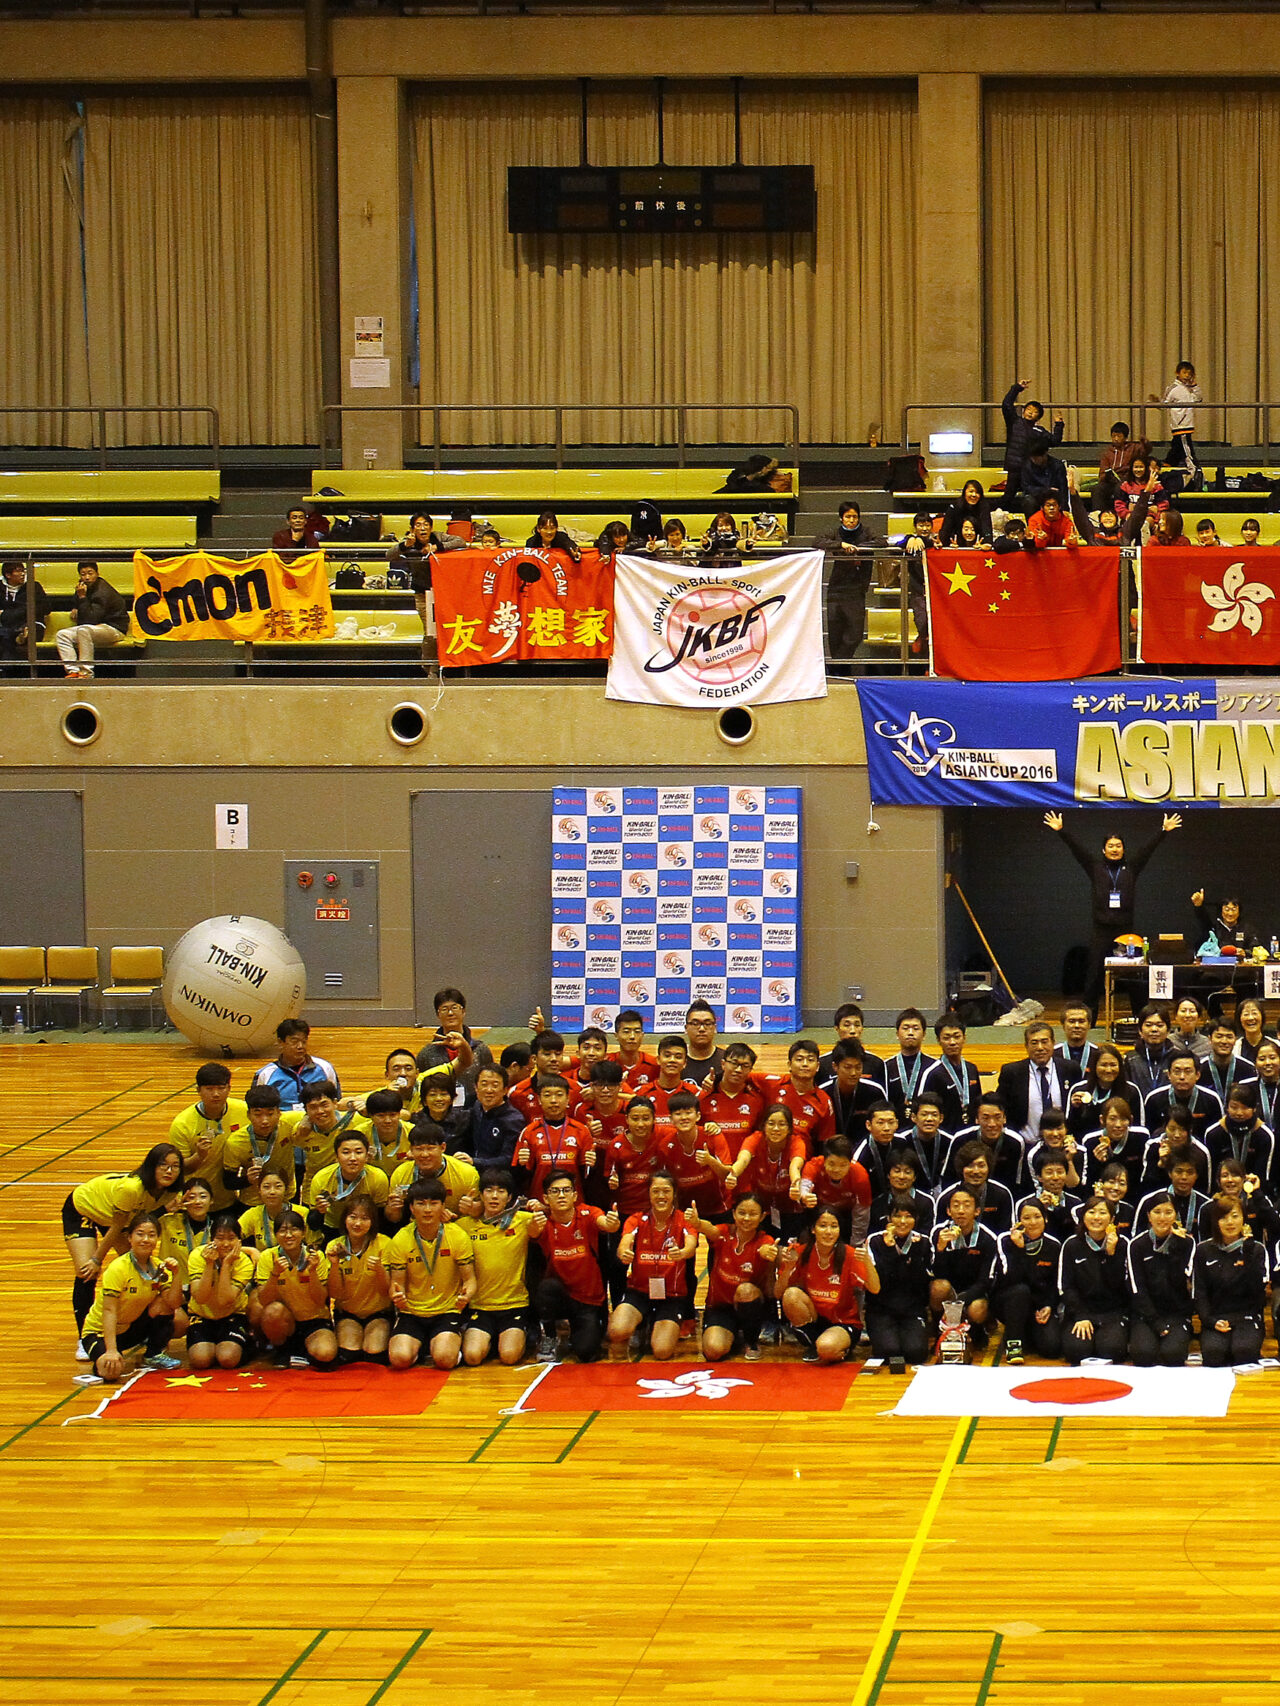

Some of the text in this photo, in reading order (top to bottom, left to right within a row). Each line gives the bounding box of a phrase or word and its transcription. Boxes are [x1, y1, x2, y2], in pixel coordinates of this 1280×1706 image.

[482, 547, 568, 597] MIE KIN-BALL TEAM
[653, 575, 762, 636] JAPAN KIN-BALL sport
[699, 662, 770, 699] FEDERATION
[945, 765, 1053, 779] ASIAN CUP 2016
[948, 752, 995, 763] KIN-BALL
[227, 809, 239, 825] B
[206, 944, 268, 989] KIN-BALL
[1155, 970, 1168, 994] 集計
[180, 984, 252, 1027] OMNIKIN
[554, 1248, 577, 1256] CROWN
